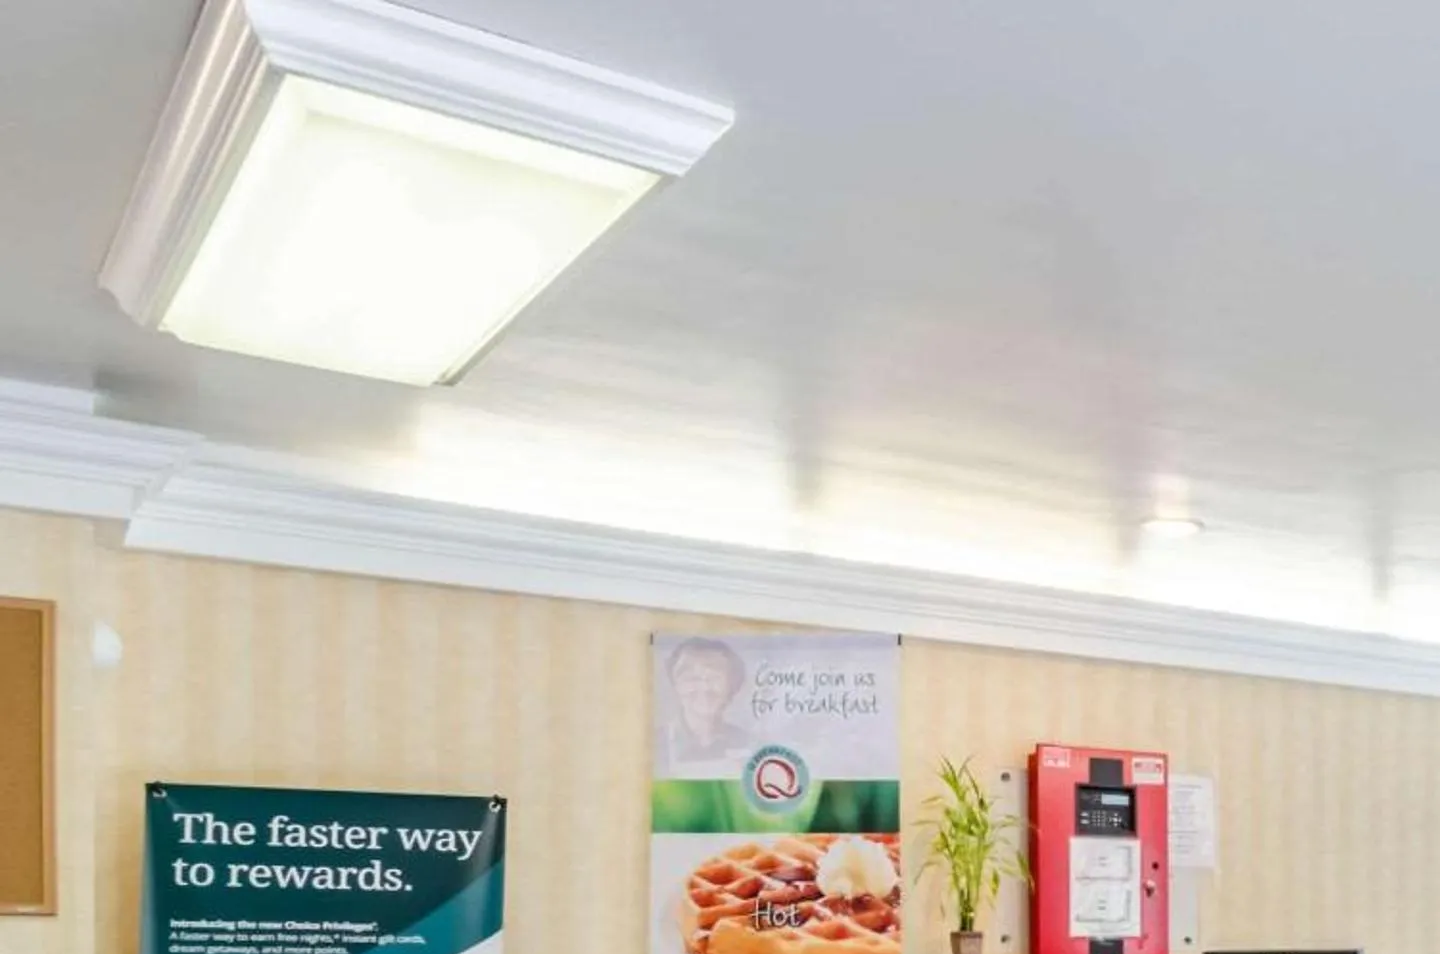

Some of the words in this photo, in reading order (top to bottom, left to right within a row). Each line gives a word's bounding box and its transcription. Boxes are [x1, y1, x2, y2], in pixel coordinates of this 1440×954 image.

[754, 661, 804, 687] Come
[809, 665, 845, 696] join
[854, 671, 876, 686] us
[751, 690, 780, 719] for
[784, 690, 880, 720] breakfast
[172, 812, 256, 845] The
[267, 815, 389, 850] faster
[397, 826, 483, 861] way
[171, 857, 214, 886] to
[226, 859, 413, 892] rewards.
[237, 919, 257, 930] the
[284, 920, 320, 930] Choice
[751, 902, 801, 930] Hot
[169, 931, 177, 940] A
[180, 931, 209, 941] faster
[212, 933, 236, 943] way
[237, 933, 249, 942] to
[250, 933, 275, 942] earn
[278, 932, 298, 942] free
[378, 933, 395, 945] gift
[261, 946, 282, 954] and
[283, 946, 312, 954] more
